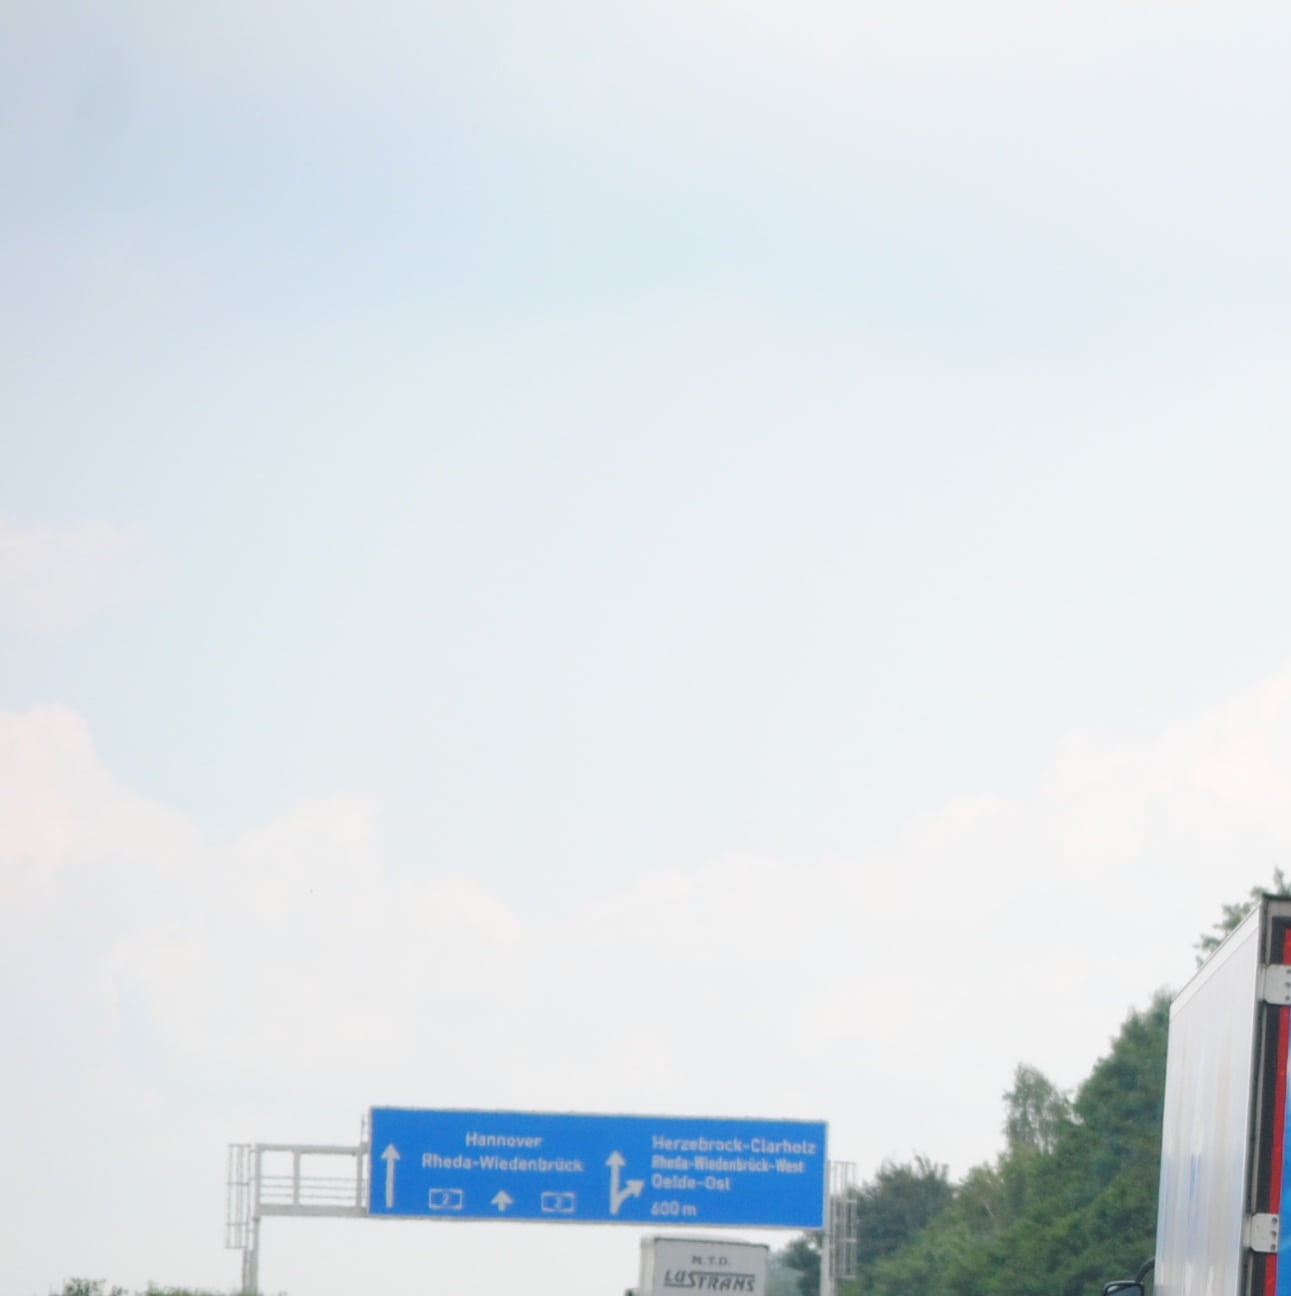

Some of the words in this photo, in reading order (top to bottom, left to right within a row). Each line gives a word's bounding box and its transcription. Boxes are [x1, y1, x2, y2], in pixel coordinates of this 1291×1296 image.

[465, 1131, 543, 1148] Hannover
[651, 1135, 817, 1155] Herzebrock-Clarholz
[421, 1152, 585, 1173] Rheda-Wiedenbrück
[651, 1154, 804, 1173] Rheda-Wiedenbrück-West
[651, 1173, 732, 1191] Oelde-Ost
[651, 1201, 680, 1217] 600
[682, 1204, 697, 1217] m
[664, 1269, 756, 1293] LUSTRANS
